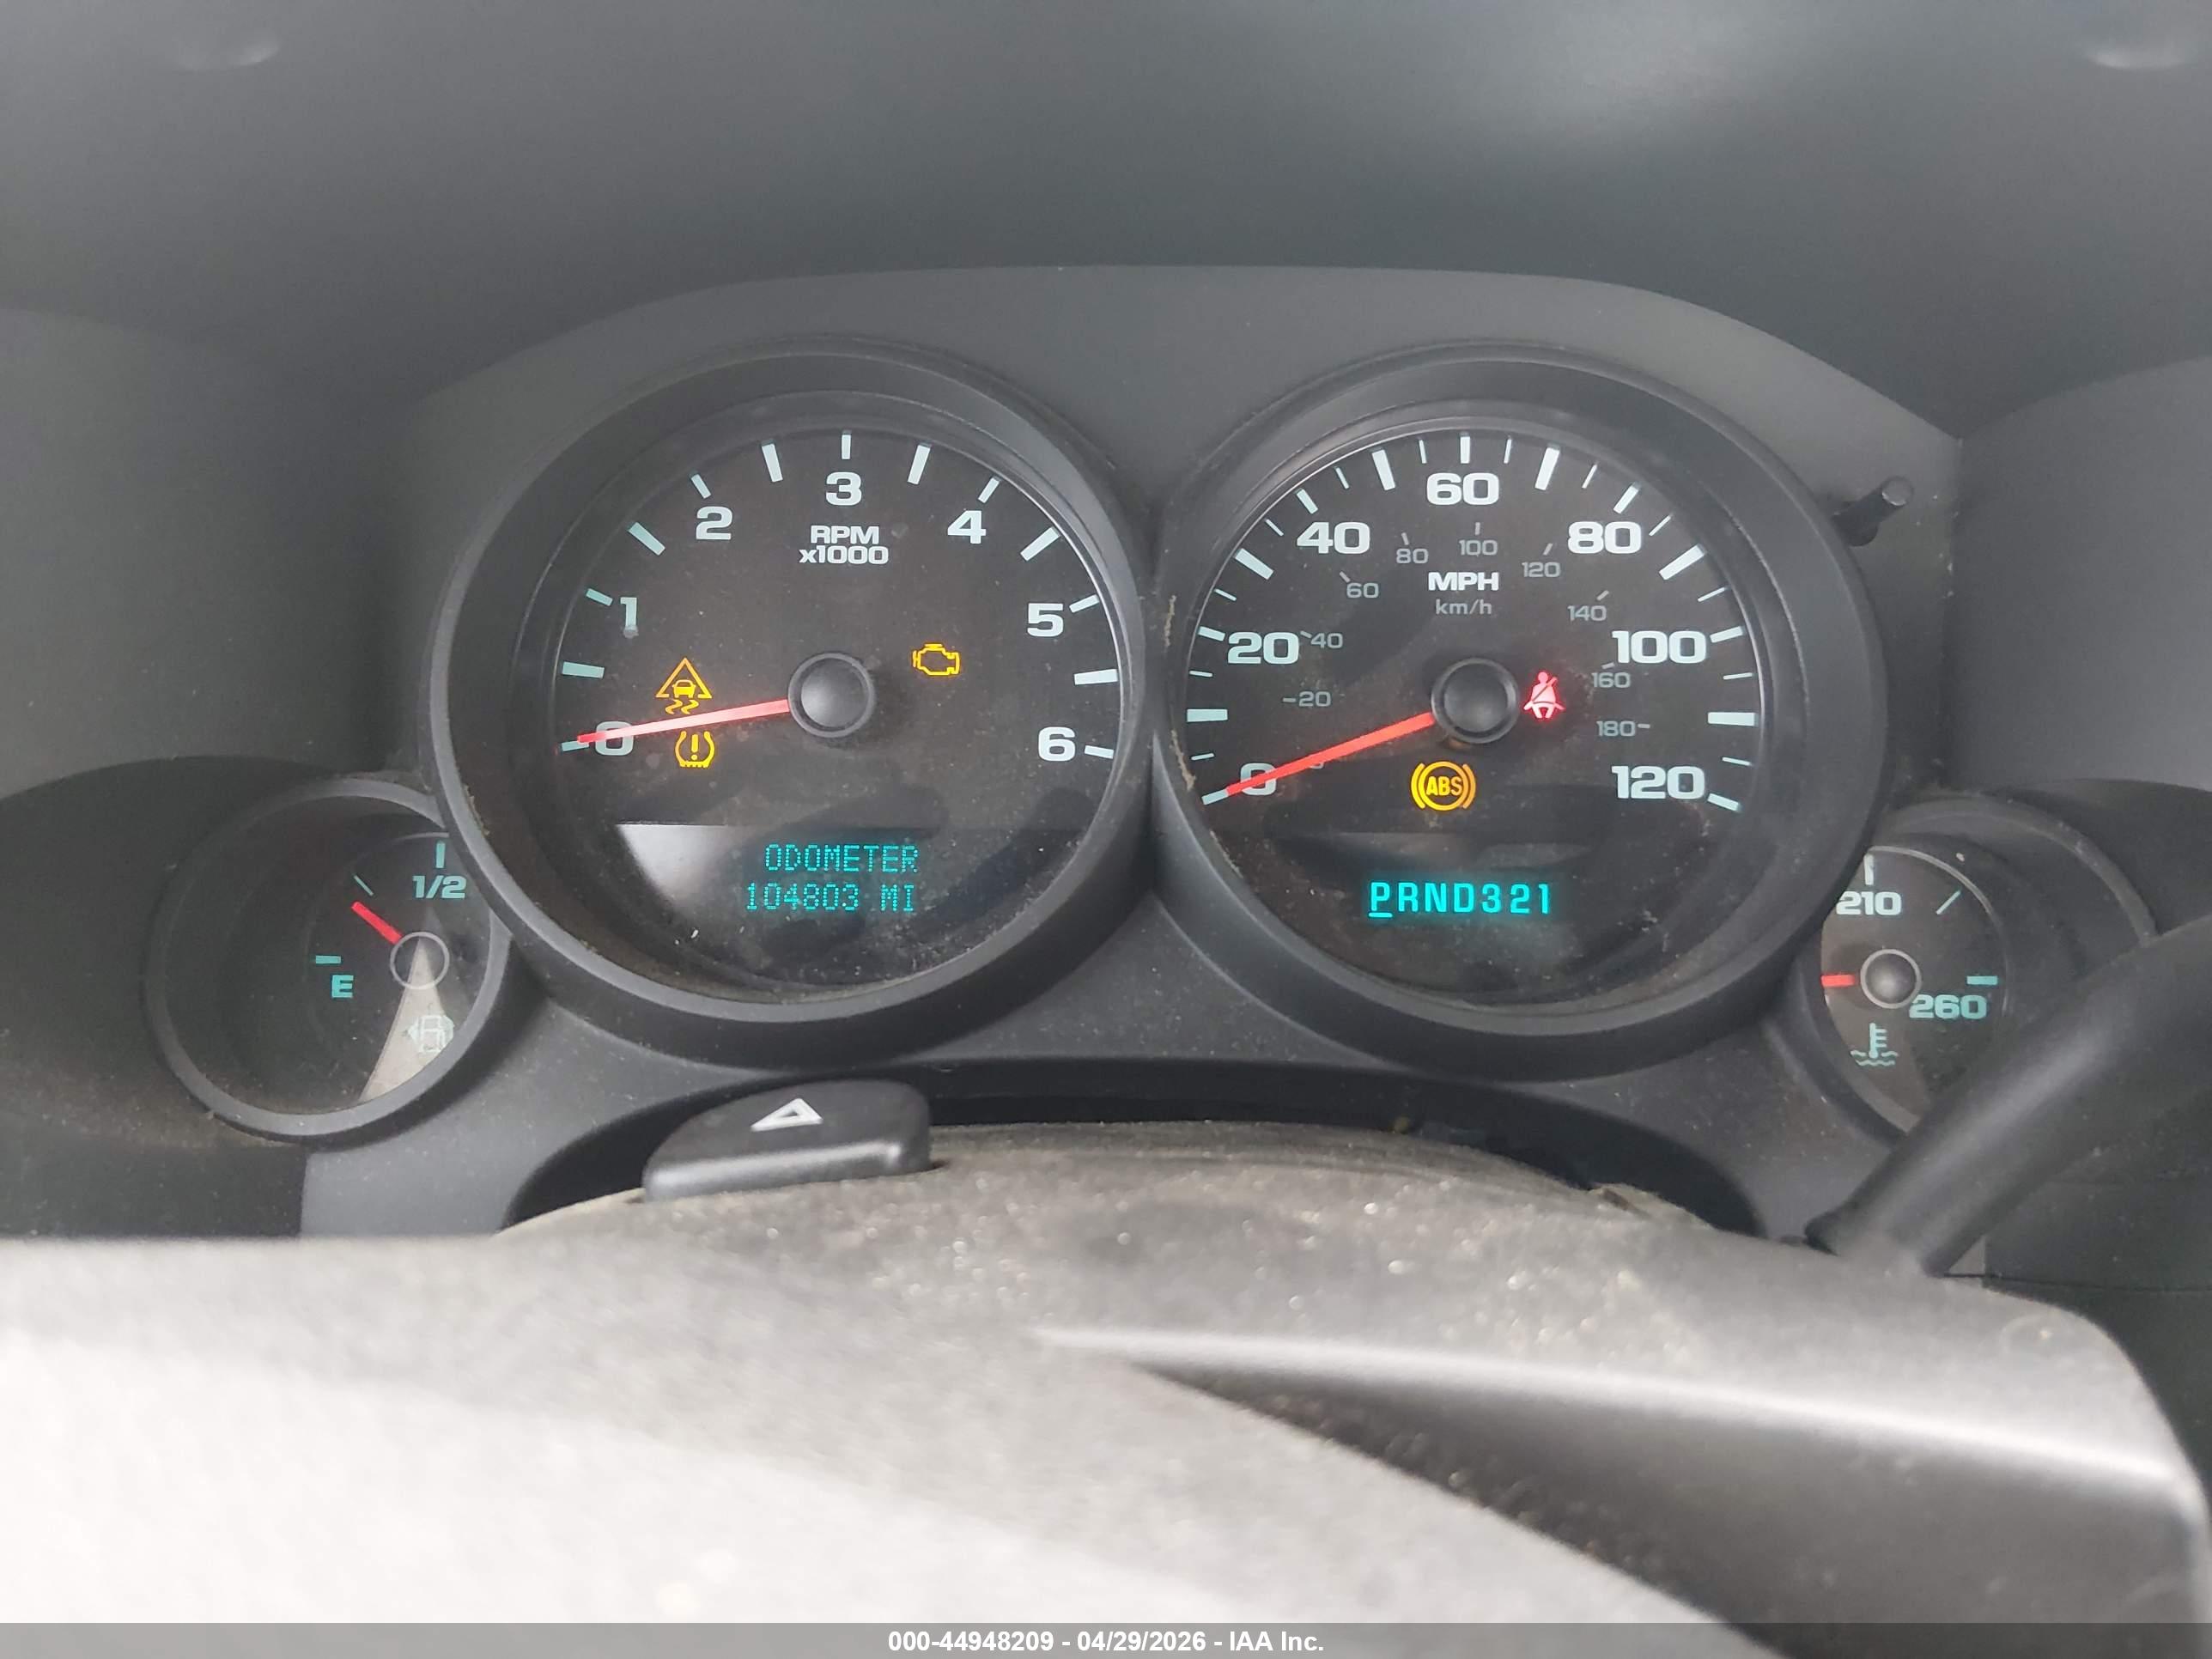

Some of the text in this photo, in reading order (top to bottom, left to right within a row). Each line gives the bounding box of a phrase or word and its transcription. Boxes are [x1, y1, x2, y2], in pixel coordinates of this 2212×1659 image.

[825, 471, 862, 506] 3
[1426, 472, 1499, 506] 60
[695, 507, 732, 541] 2
[810, 526, 879, 545] RPM
[948, 510, 987, 544] 4
[1297, 521, 1370, 555] 40
[1459, 539, 1498, 557] 100
[1567, 521, 1642, 555] 80
[799, 545, 889, 565] x1000
[1395, 548, 1429, 565] 80
[1428, 571, 1499, 592] MPH
[1522, 561, 1561, 579] 120
[1346, 581, 1379, 599] 60
[620, 598, 638, 635] 1
[1027, 603, 1064, 637] 5
[1435, 599, 1492, 616] km/h
[1567, 604, 1607, 622] 140
[1227, 632, 1299, 665] 20
[1310, 631, 1344, 649] 40
[1612, 630, 1706, 664] 100
[1592, 672, 1631, 690] 160
[1297, 690, 1331, 708] 20
[595, 721, 634, 757] 0
[1597, 720, 1636, 738] 180
[1037, 726, 1076, 762] 6
[1239, 763, 1277, 796] 0
[1425, 775, 1463, 796] ABS
[1612, 767, 1705, 799] 120
[764, 844, 919, 873] ODOMETER
[412, 875, 466, 899] 1/2
[746, 884, 915, 912] 104803 MI
[1369, 882, 1551, 915] PRND321
[1835, 891, 1902, 915] 210
[331, 975, 354, 998] E
[1909, 994, 1987, 1019] 260
